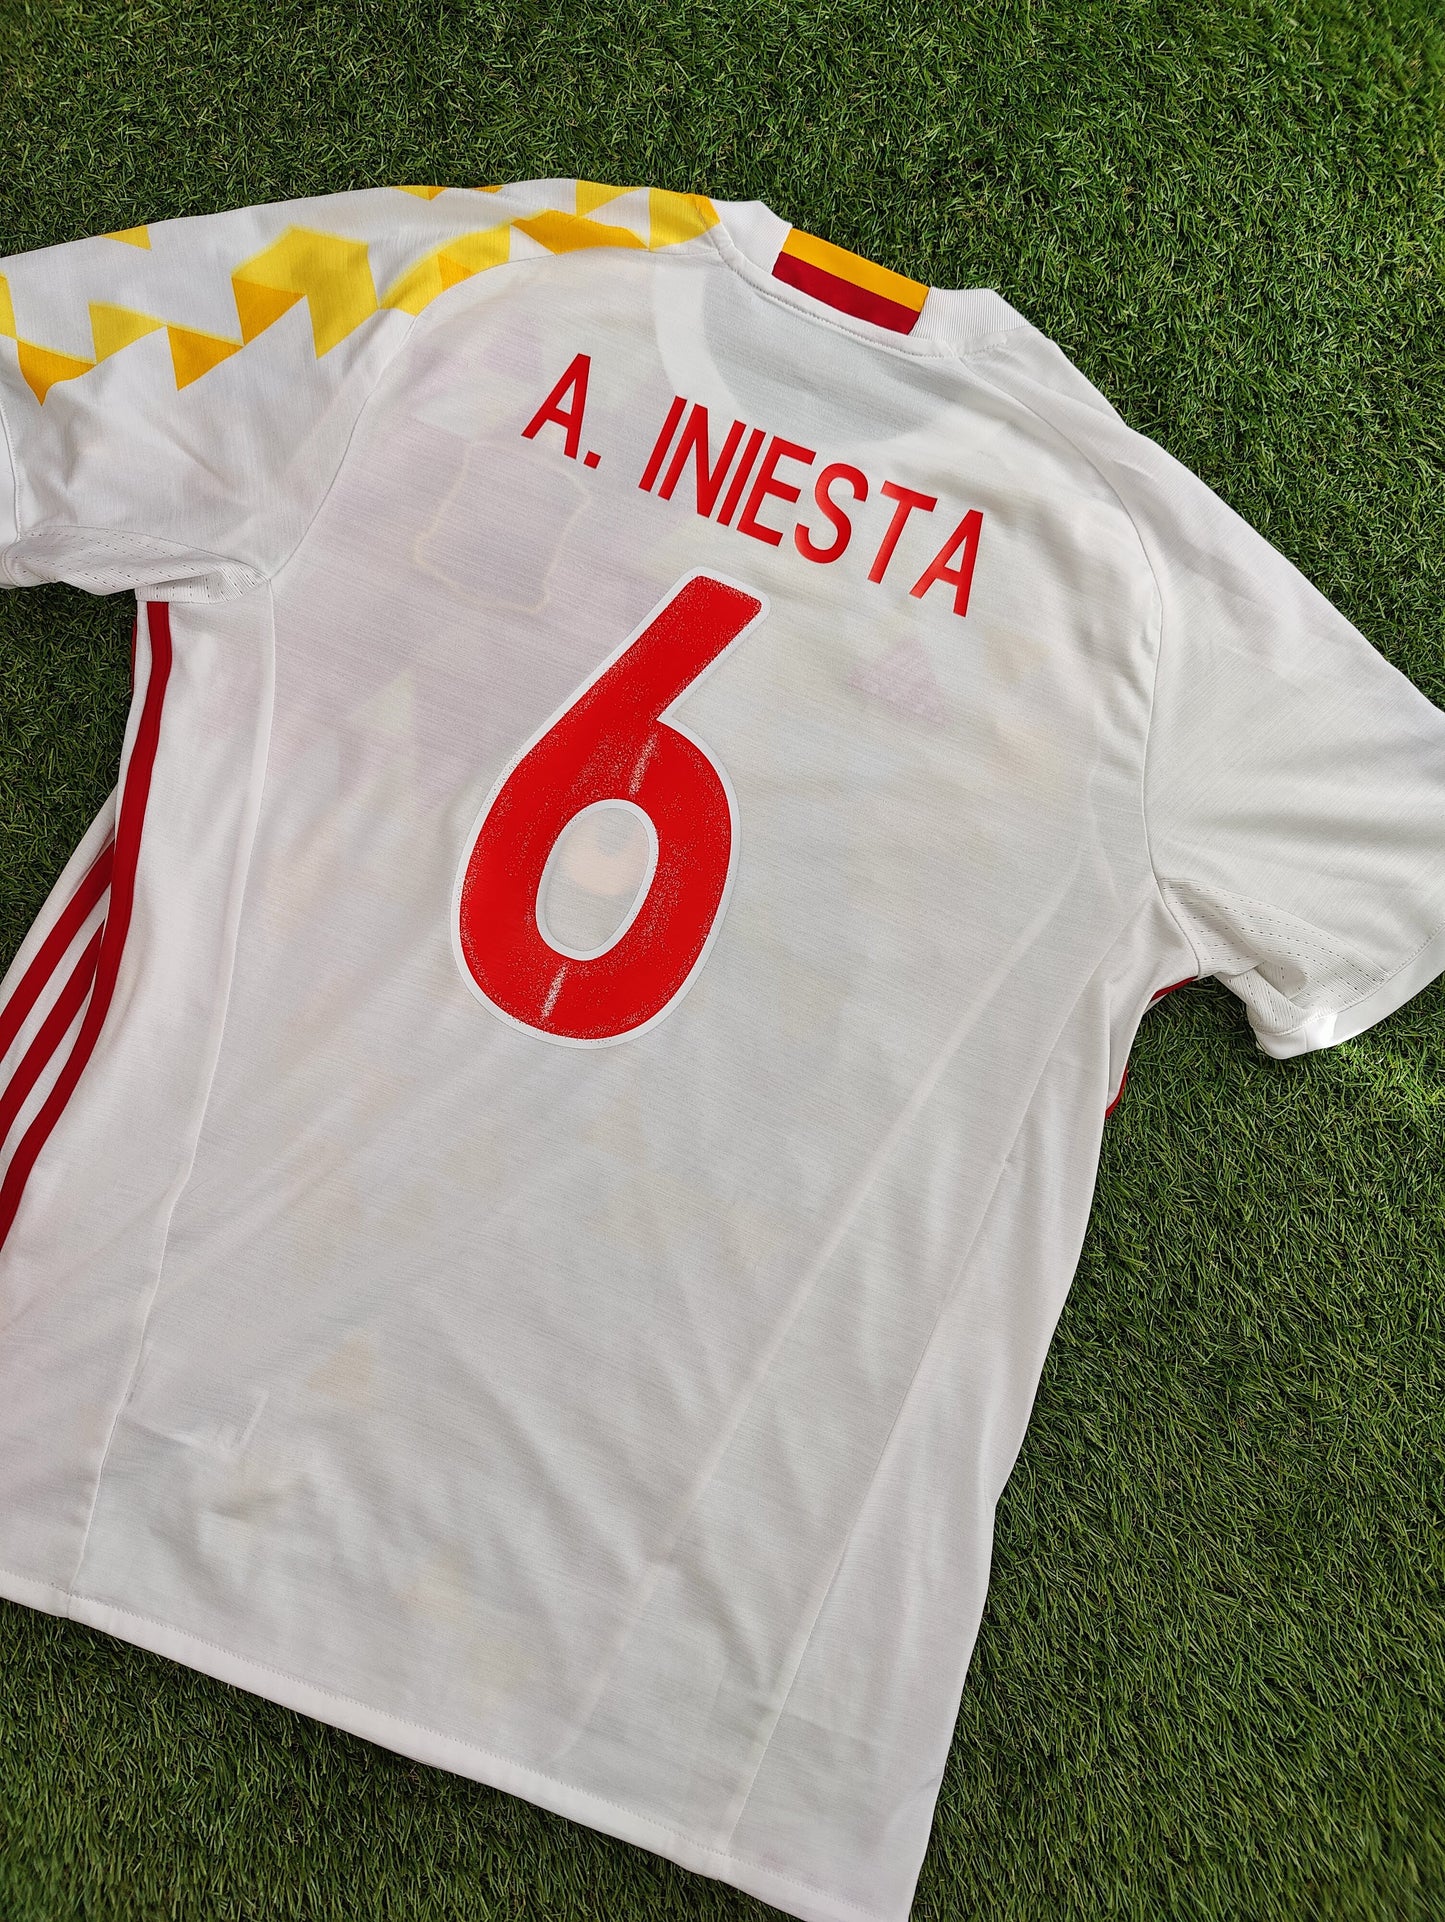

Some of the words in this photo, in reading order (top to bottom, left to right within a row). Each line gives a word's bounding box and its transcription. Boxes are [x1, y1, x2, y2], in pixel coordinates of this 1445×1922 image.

[522, 353, 601, 469] A.
[638, 396, 984, 617] INIESTA
[455, 571, 766, 1044] 6
